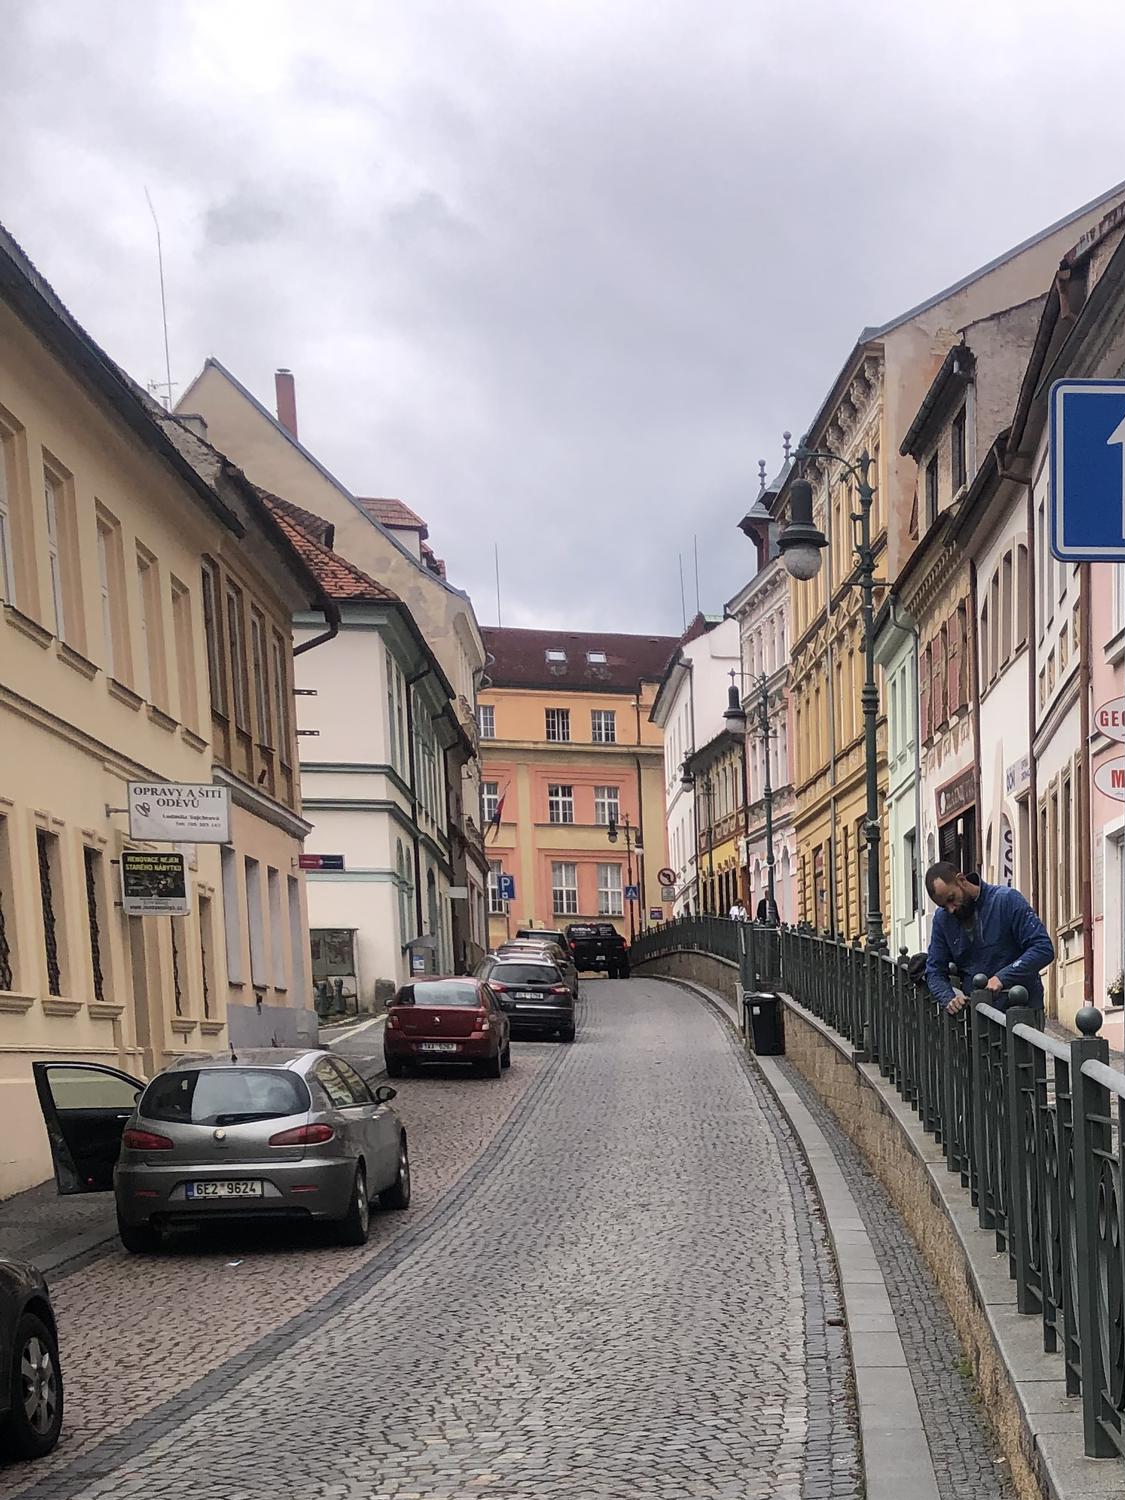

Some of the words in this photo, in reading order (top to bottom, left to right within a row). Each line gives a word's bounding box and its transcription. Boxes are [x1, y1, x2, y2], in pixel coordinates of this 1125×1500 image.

[133, 786, 182, 797] OPRAVY
[186, 789, 195, 798] A
[198, 787, 222, 798] ŠITÍ
[156, 797, 200, 808] ODĚVŮ
[501, 877, 511, 892] P
[196, 1183, 218, 1195] 6E2
[227, 1182, 256, 1194] 9624
